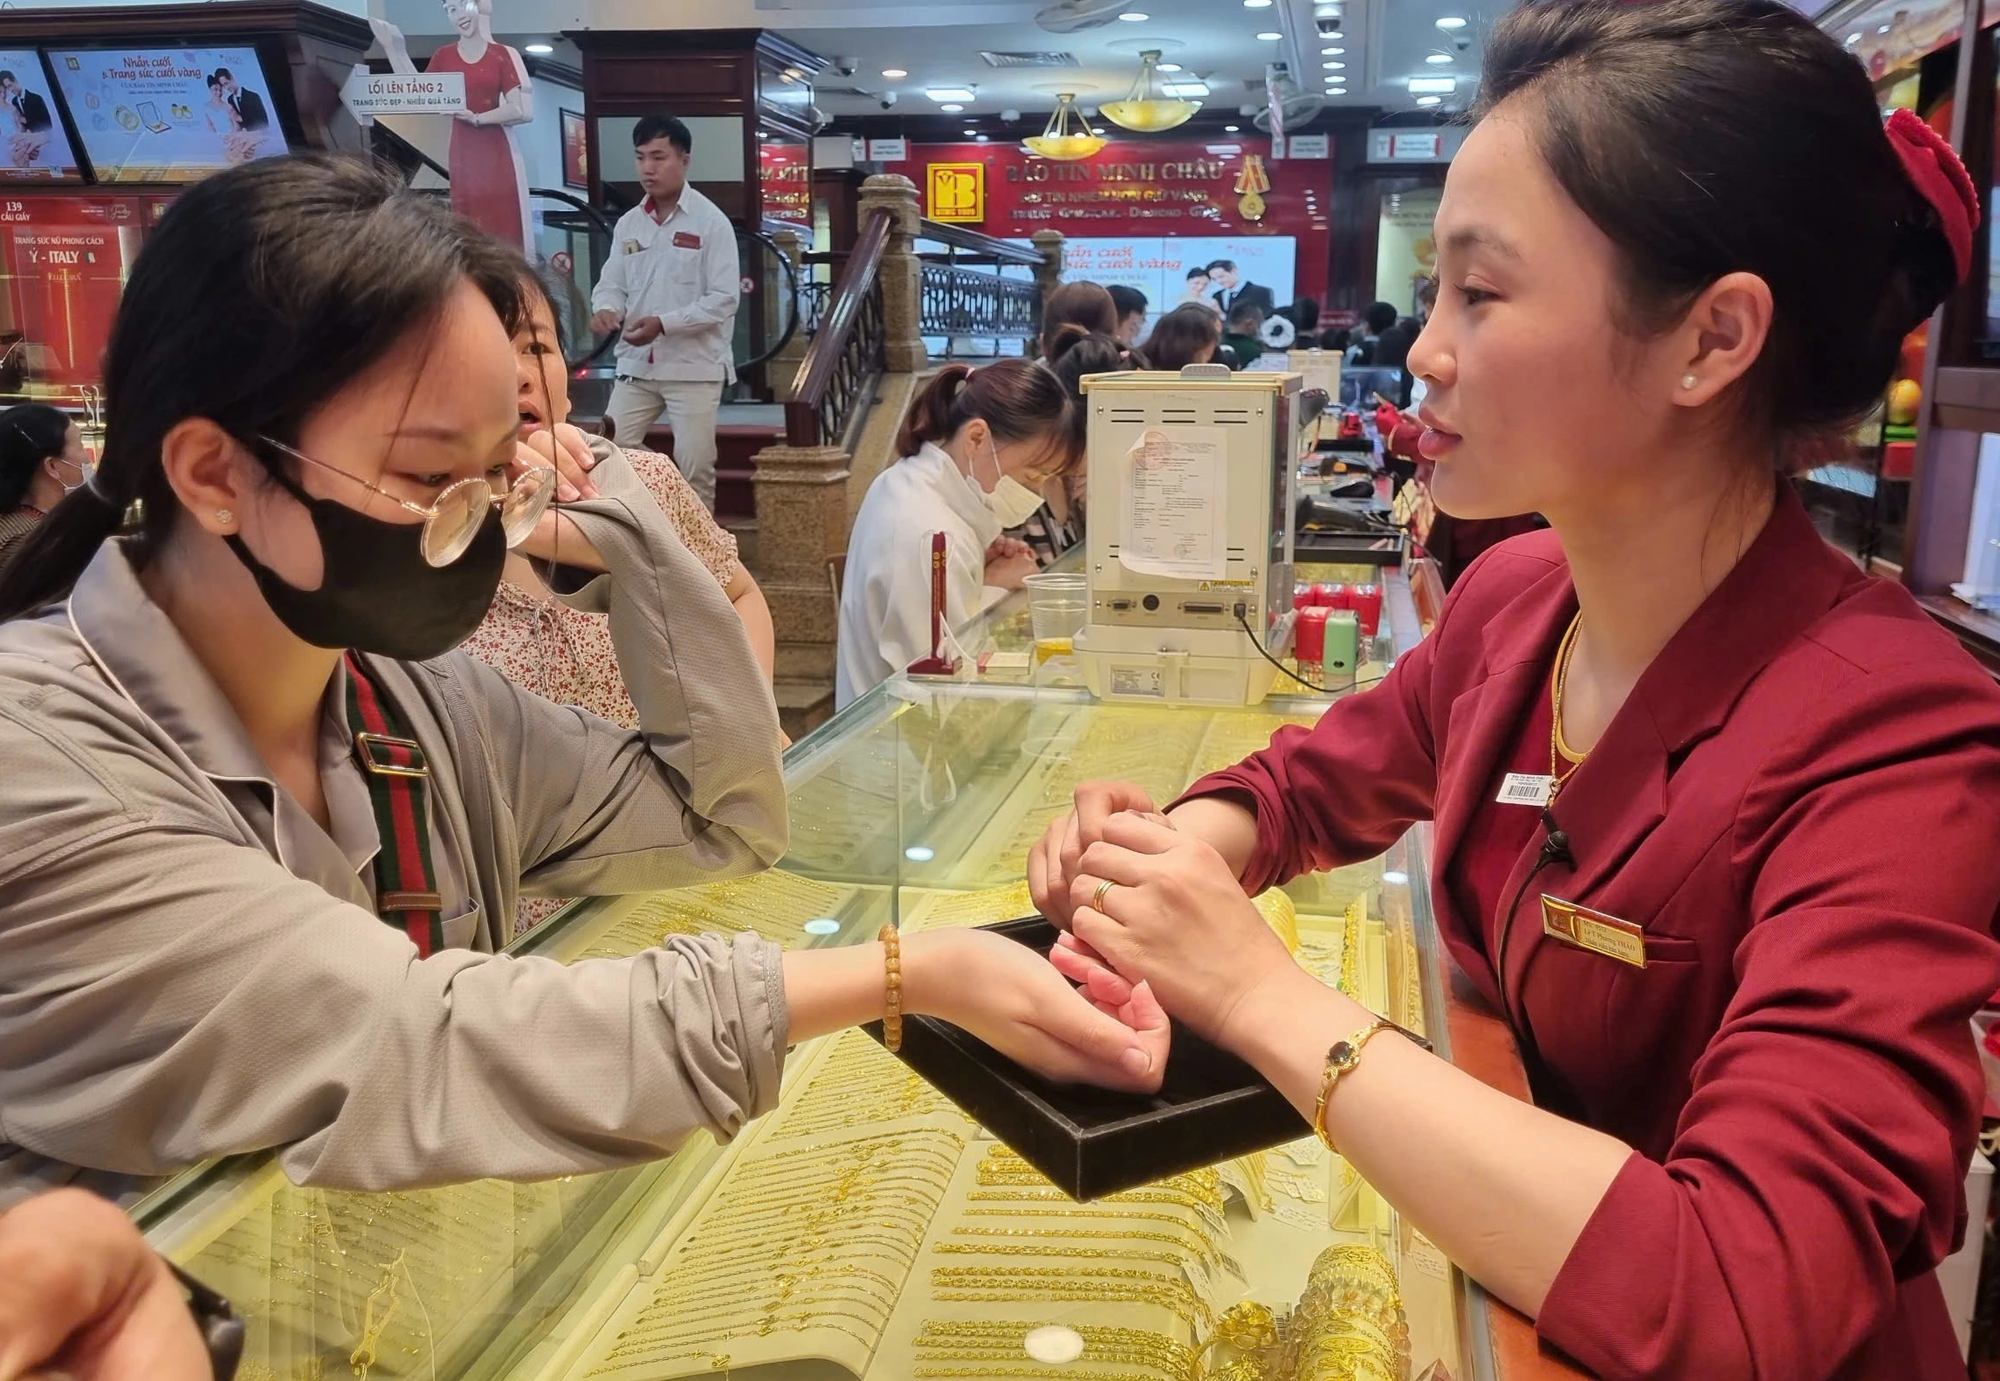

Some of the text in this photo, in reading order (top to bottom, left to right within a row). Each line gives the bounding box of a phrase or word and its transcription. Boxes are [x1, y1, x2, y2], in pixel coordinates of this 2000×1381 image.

[123, 55, 172, 68] Nhẫn cưới
[109, 68, 137, 81] Trang
[138, 67, 154, 79] sức
[156, 67, 176, 79] cưới
[177, 67, 202, 80] vàng
[368, 79, 385, 94] LỐI
[387, 81, 403, 94] LÊN
[437, 83, 444, 93] 2
[353, 99, 374, 107] TRANG
[390, 99, 401, 107] ĐẸP
[406, 96, 426, 106] NHIỀU
[428, 97, 441, 105] QUÀ
[1096, 163, 1155, 181] MINH
[1161, 157, 1223, 180] CHÂU
[6, 201, 22, 212] 139
[1, 211, 31, 221] CẦU GIẤY
[14, 237, 36, 245] TRANG
[62, 237, 85, 245] PHONG
[86, 235, 104, 245] CÁCH
[29, 247, 39, 264] Ý
[50, 250, 80, 264] ITALY
[1139, 257, 1182, 271] vàng
